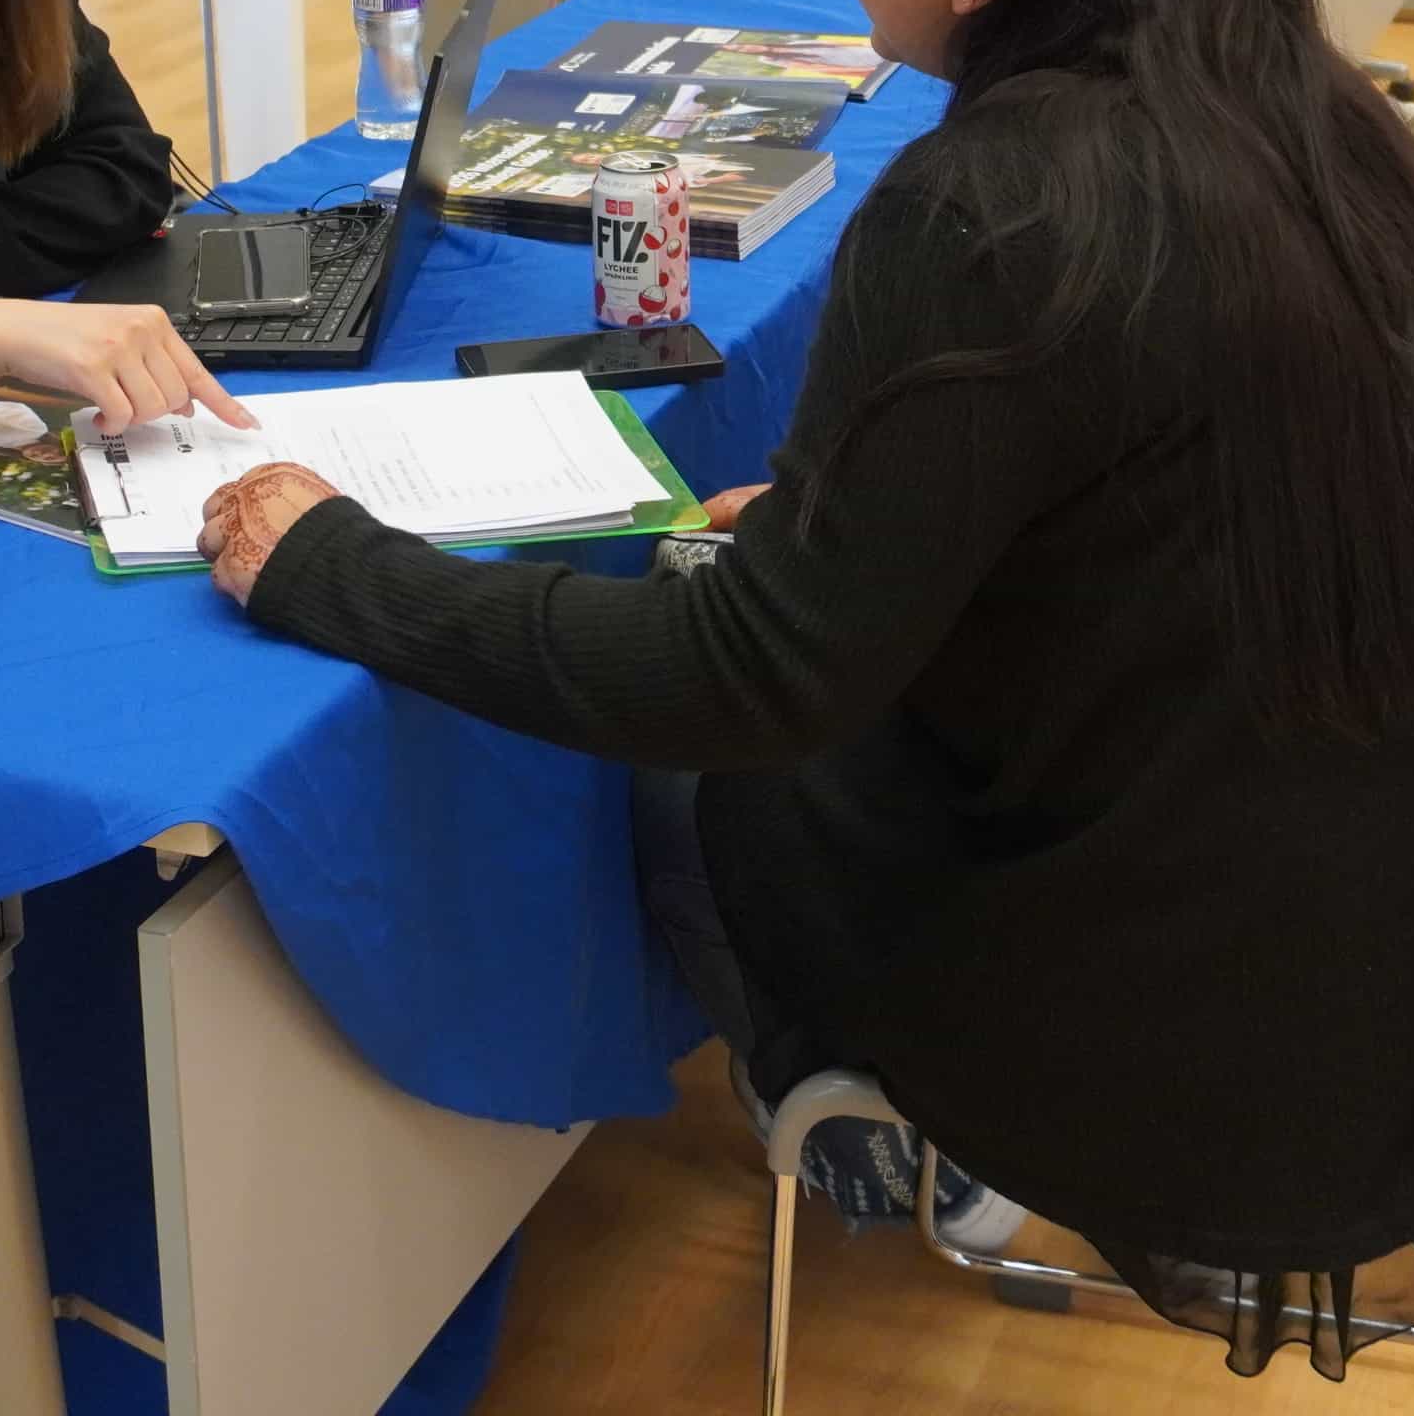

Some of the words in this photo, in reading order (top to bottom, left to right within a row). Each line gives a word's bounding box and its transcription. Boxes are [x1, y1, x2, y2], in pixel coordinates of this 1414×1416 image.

[597, 216, 649, 264] FIZ
[603, 263, 639, 275] LYCHEE
[603, 272, 639, 282] SPARKLING
